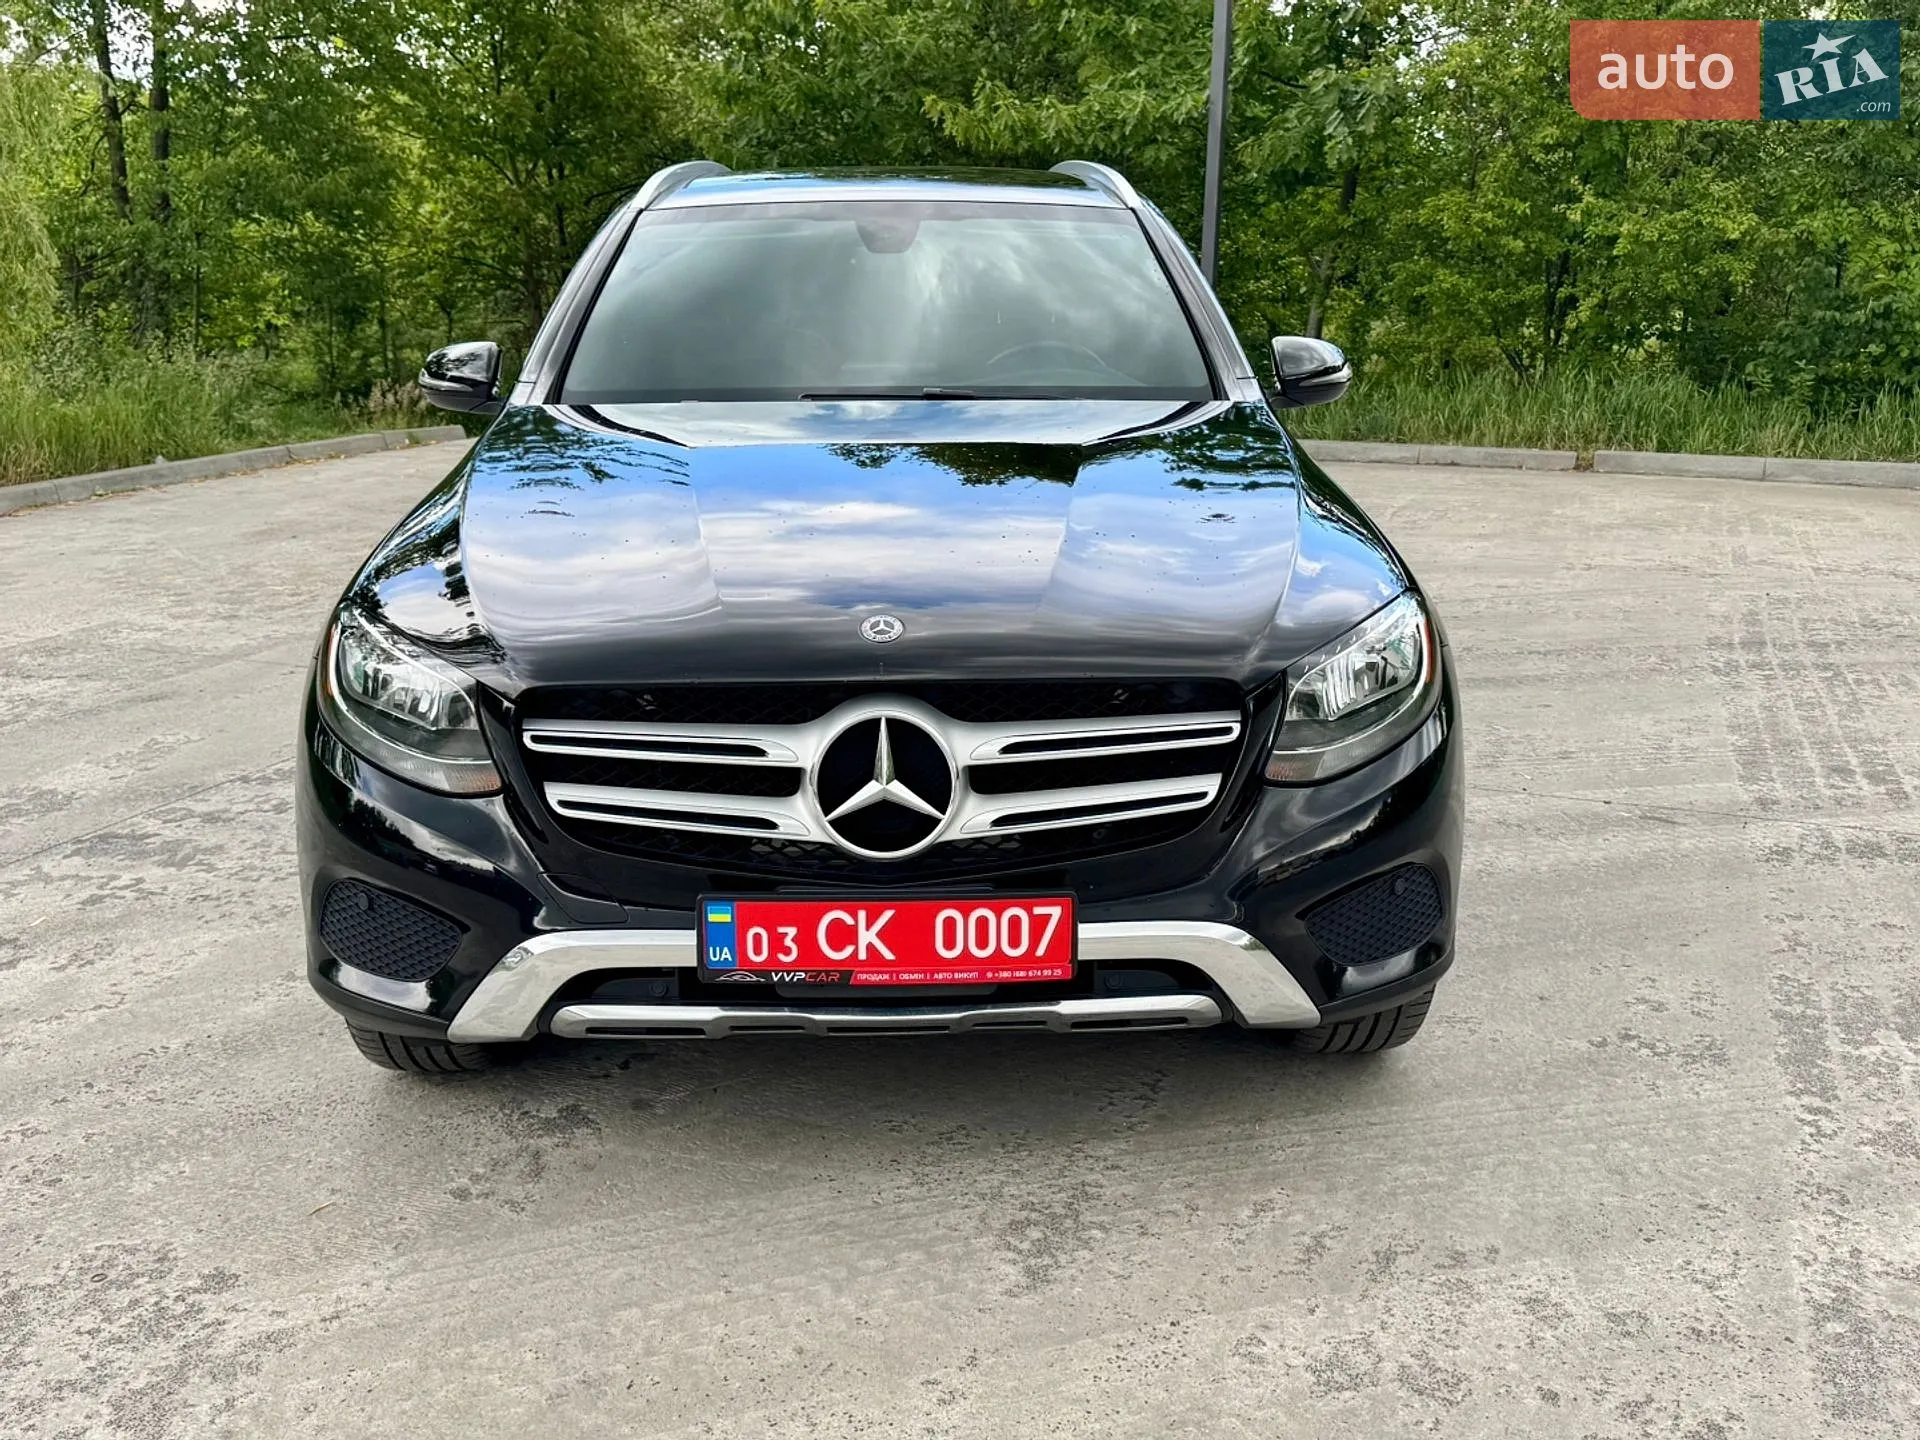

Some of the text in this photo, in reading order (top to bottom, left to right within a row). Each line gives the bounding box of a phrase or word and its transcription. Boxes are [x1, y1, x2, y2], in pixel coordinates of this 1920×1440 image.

[746, 905, 1064, 963] 03 CK 0007
[709, 946, 732, 962] UA
